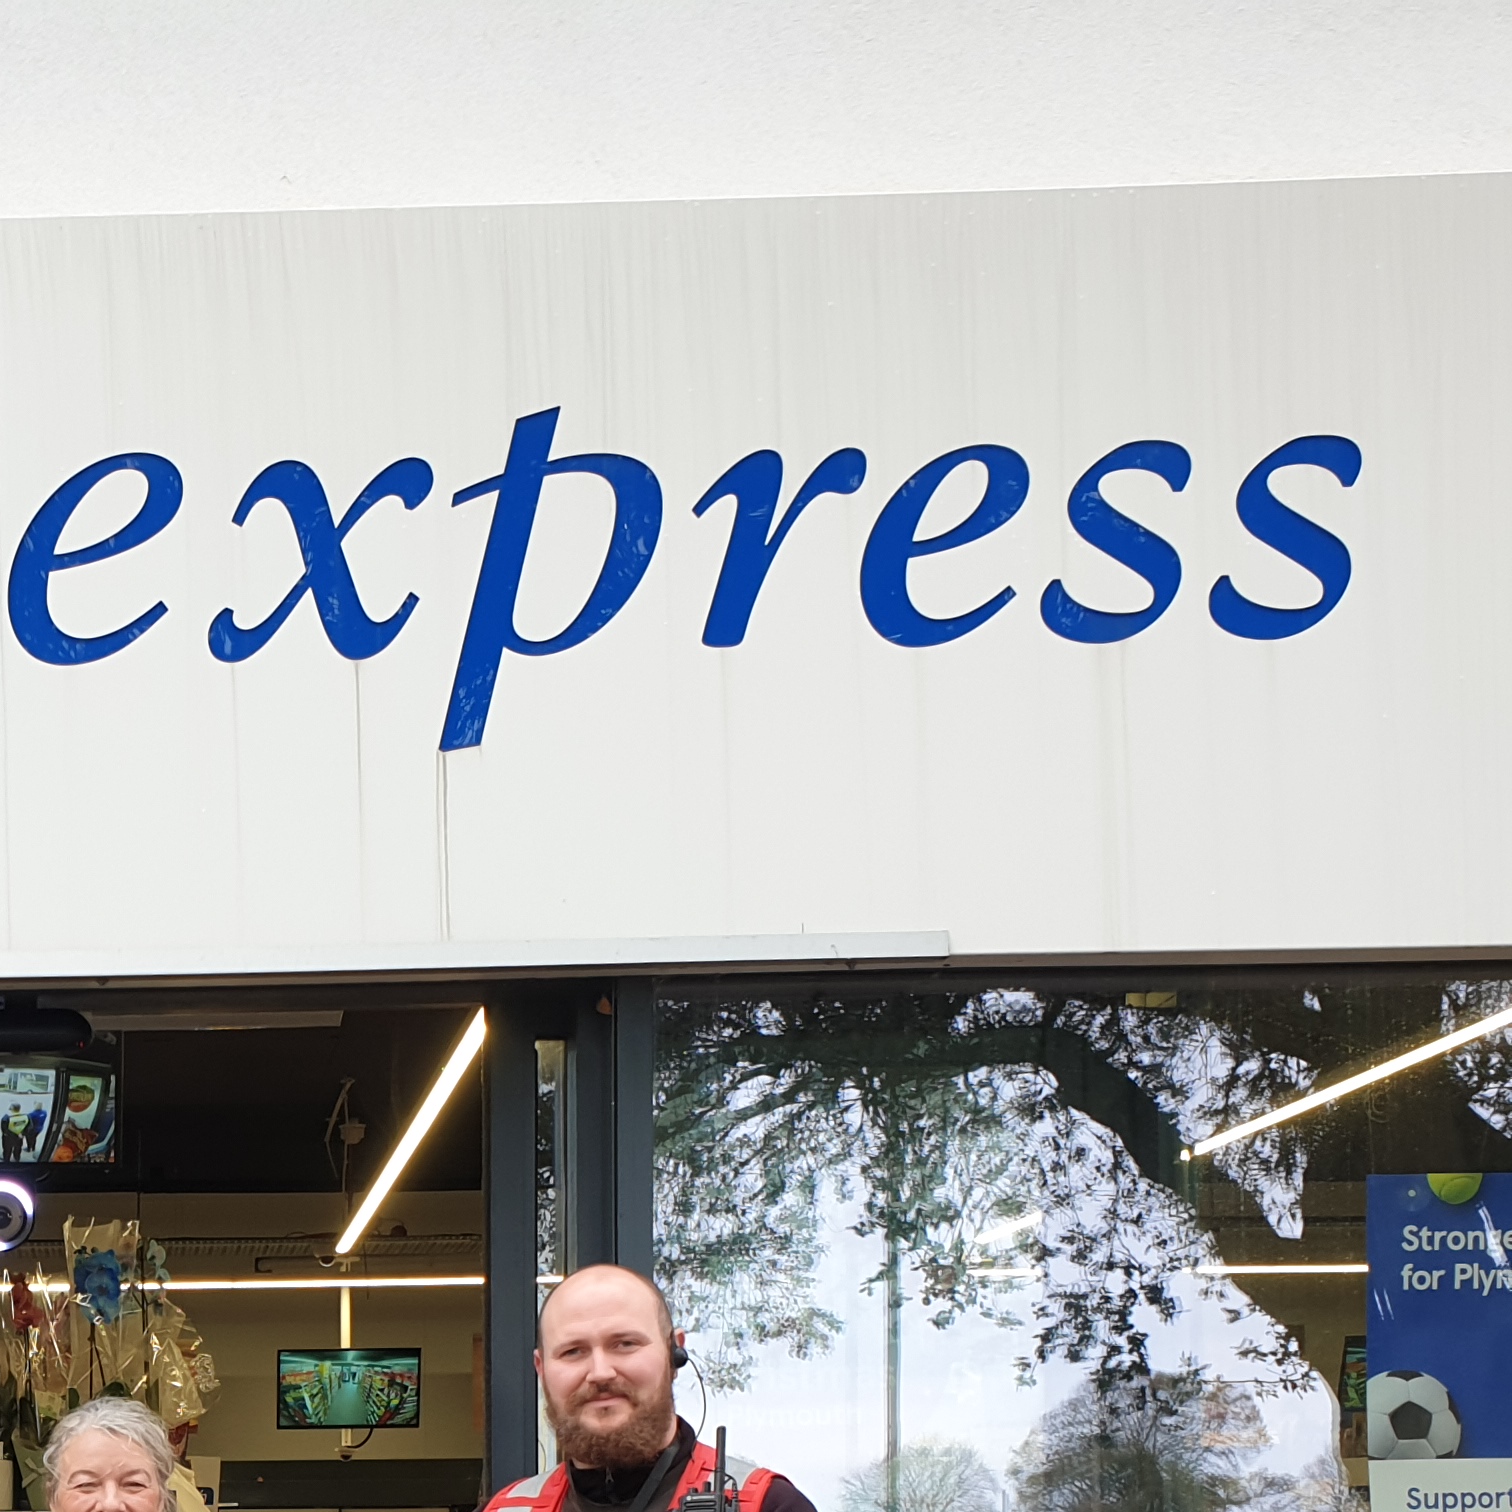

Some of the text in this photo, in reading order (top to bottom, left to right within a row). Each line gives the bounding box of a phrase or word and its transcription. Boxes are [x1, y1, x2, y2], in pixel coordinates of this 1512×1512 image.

[7, 405, 1363, 752] express
[1401, 1225, 1512, 1257] Strone
[1401, 1263, 1446, 1290] for
